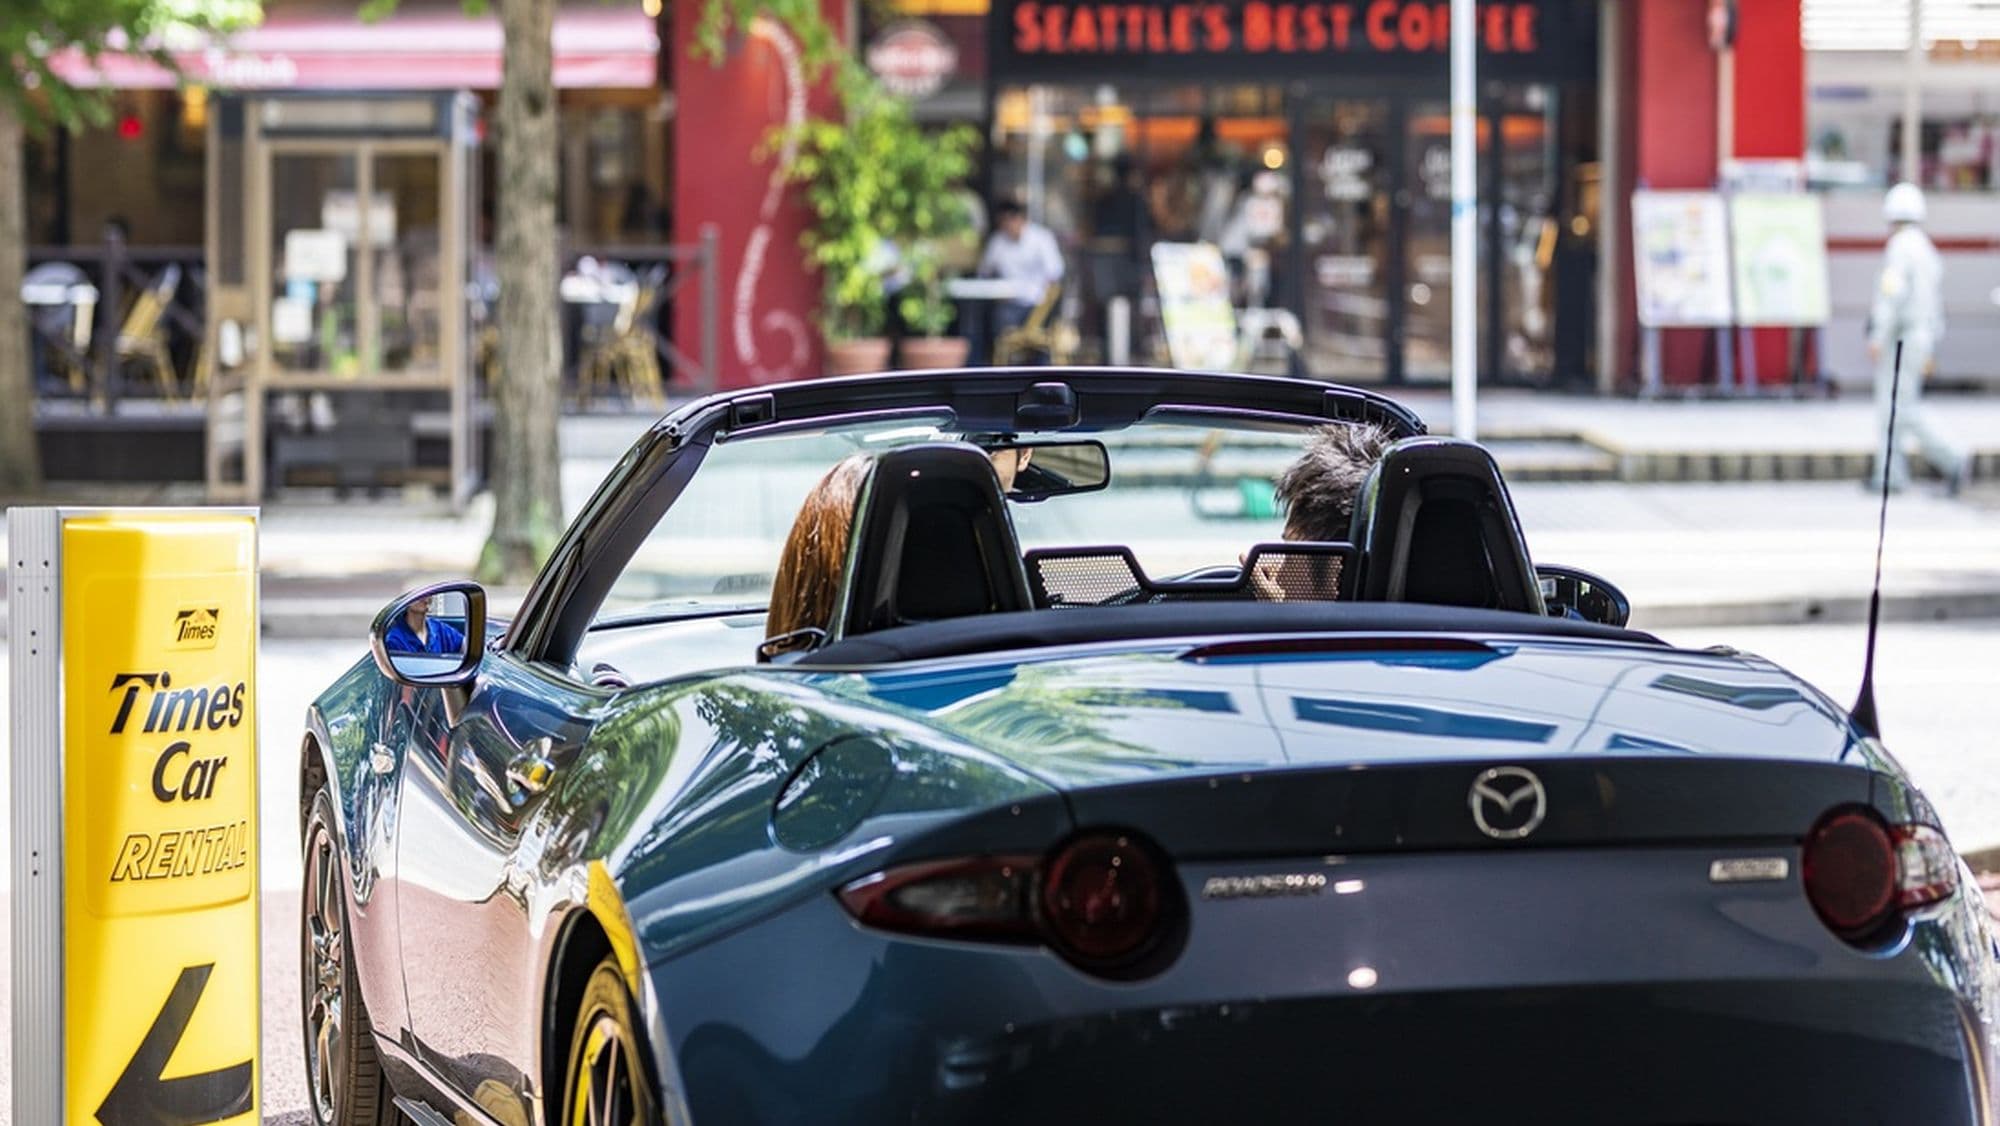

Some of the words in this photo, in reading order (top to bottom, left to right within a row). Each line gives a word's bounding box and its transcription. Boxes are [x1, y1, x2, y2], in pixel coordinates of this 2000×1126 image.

[1014, 1, 1231, 52] SEATTLE'S
[1243, 0, 1353, 52] BEST
[1365, 0, 1538, 52] COFEE
[175, 608, 219, 642] Times
[110, 672, 245, 734] Times
[152, 741, 227, 803] Car
[110, 821, 246, 882] RENTAL
